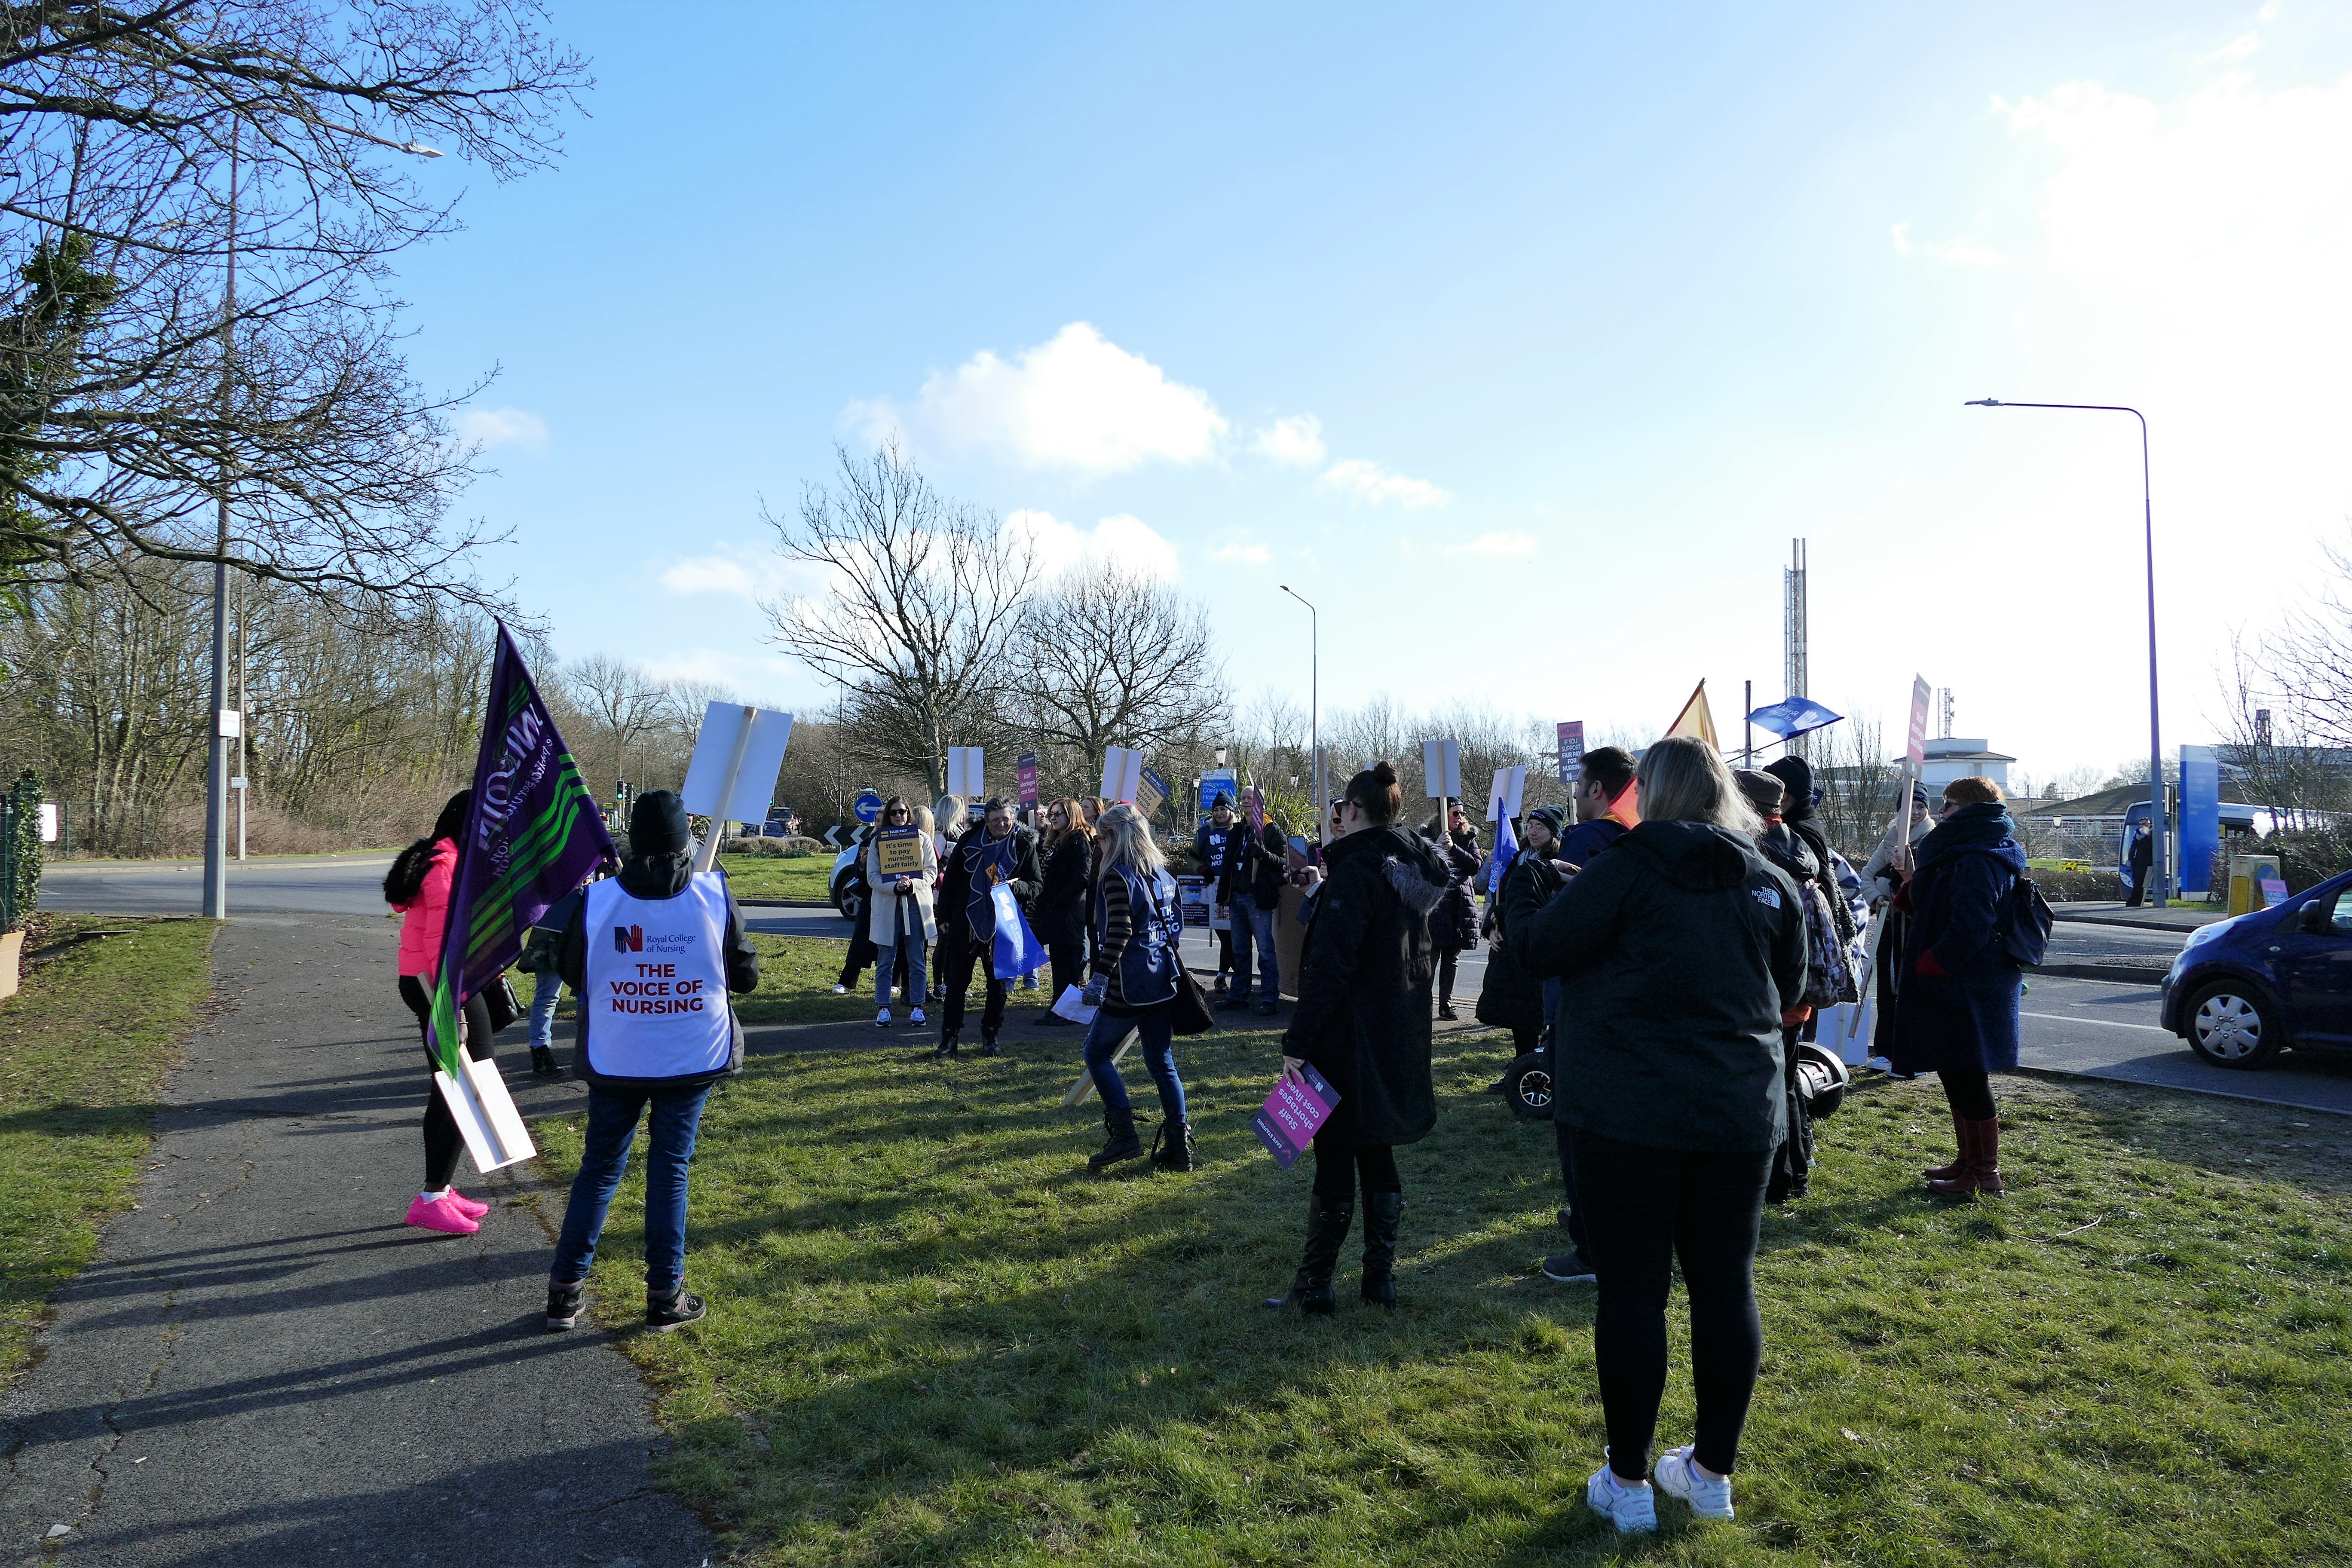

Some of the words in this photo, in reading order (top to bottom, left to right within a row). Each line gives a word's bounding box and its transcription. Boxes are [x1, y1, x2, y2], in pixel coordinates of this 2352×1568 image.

[1560, 726, 1580, 735] HONK
[1020, 780, 1035, 788] shortages
[1143, 792, 1152, 801] pay
[1147, 787, 1157, 799] time
[1139, 800, 1150, 813] fairly
[1752, 890, 1772, 900] NORTH
[1761, 886, 1772, 894] THE
[1758, 897, 1771, 906] FACE
[647, 935, 667, 945] Royal
[668, 934, 696, 944] College
[657, 945, 685, 954] Nursing
[635, 964, 676, 977] THE
[609, 981, 670, 996] VOICE
[675, 979, 703, 995] OF
[612, 998, 703, 1014] NURSING
[1286, 1081, 1305, 1102] lives
[1278, 1088, 1314, 1130] shortages
[1302, 1098, 1320, 1118] cost
[1278, 1108, 1298, 1130] Staff
[1256, 1118, 1274, 1139] STAFFING
[1272, 1136, 1283, 1149] SAFE
